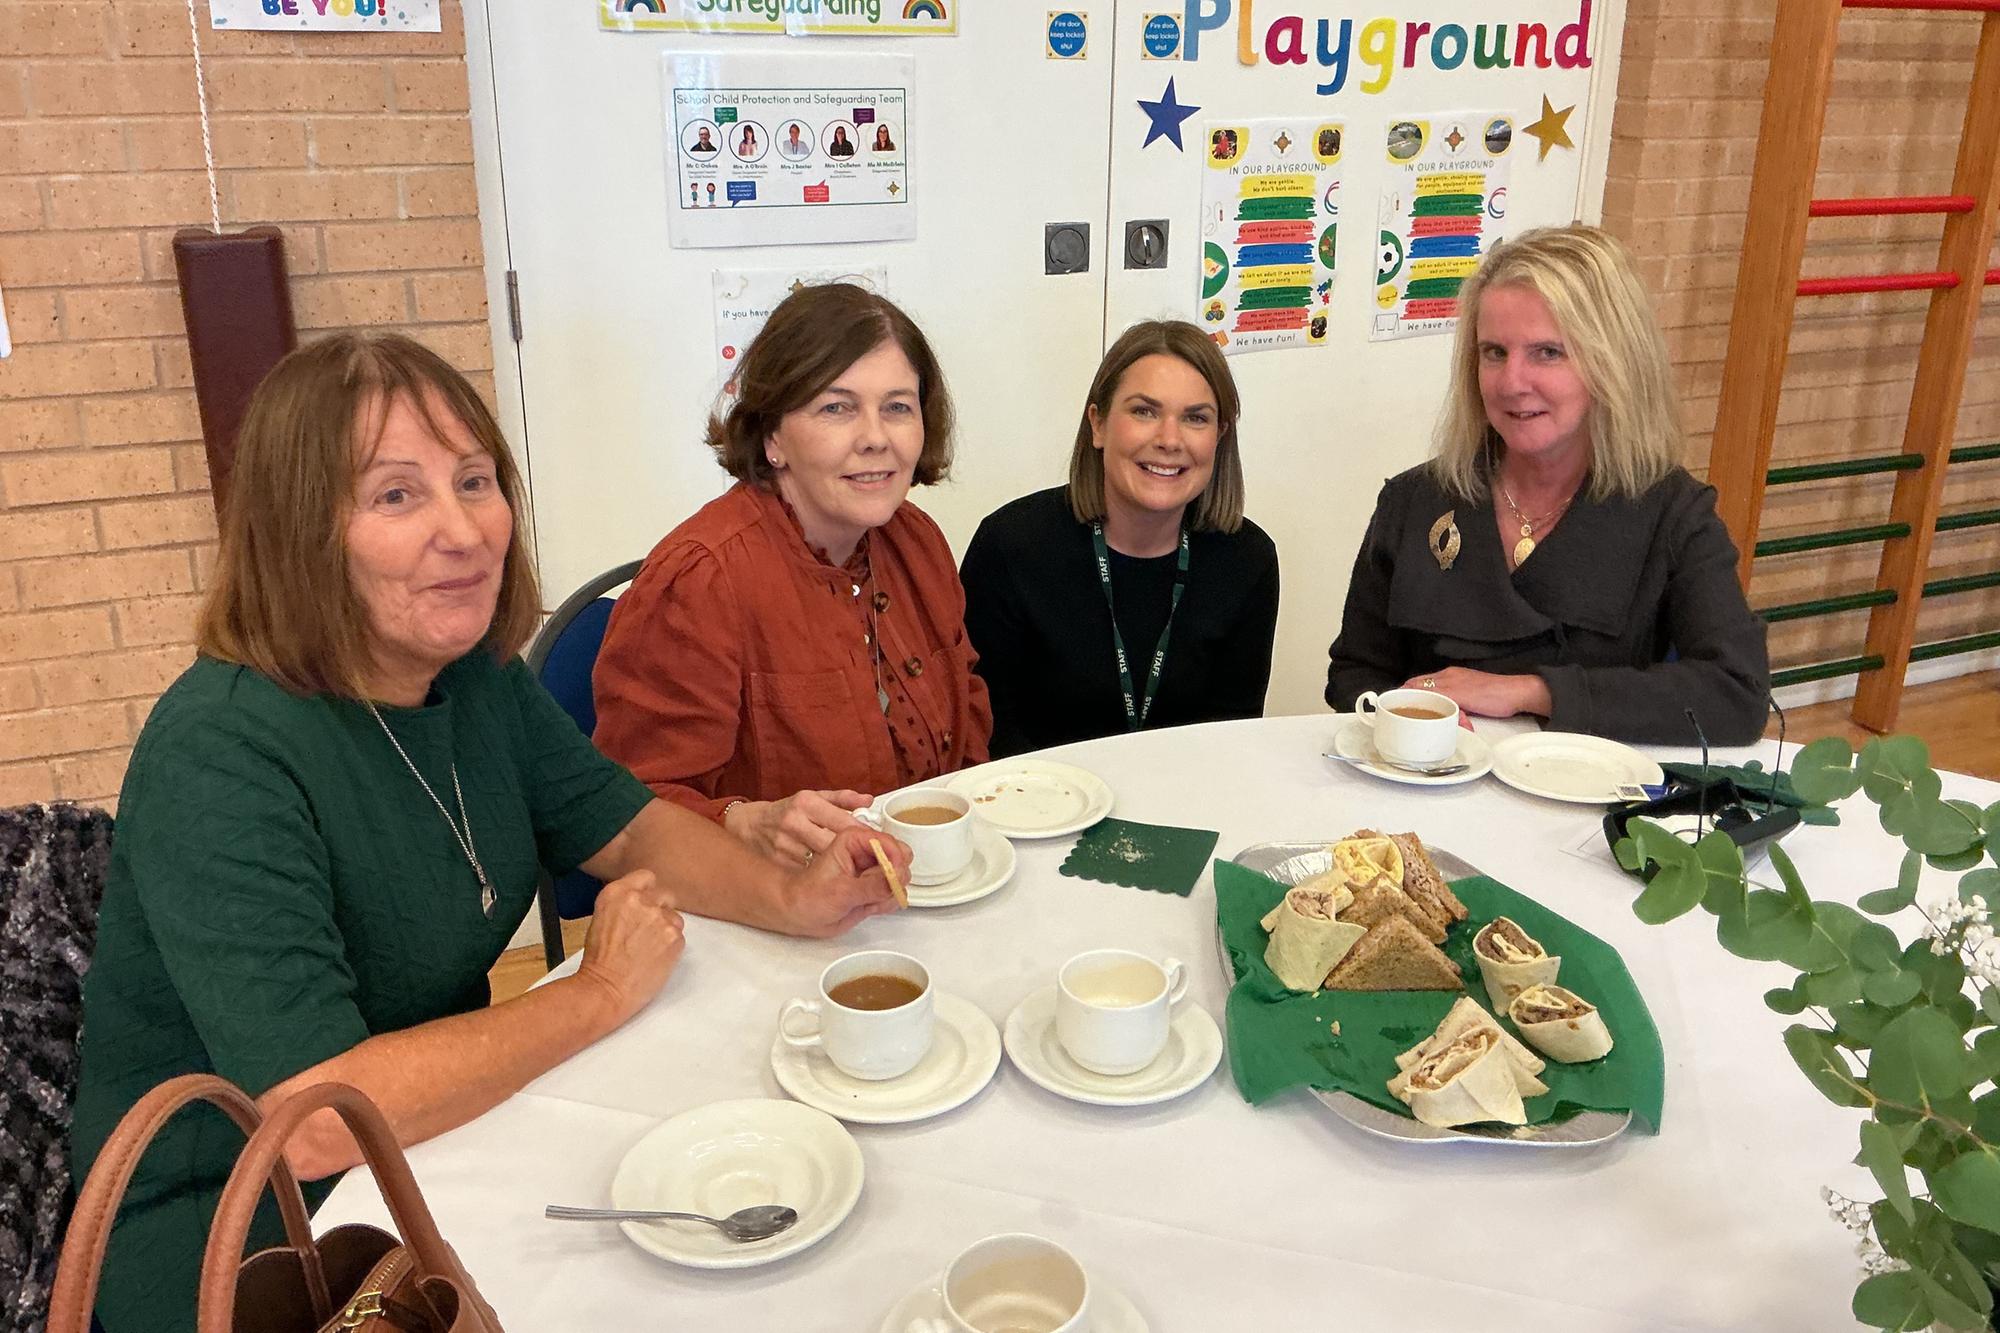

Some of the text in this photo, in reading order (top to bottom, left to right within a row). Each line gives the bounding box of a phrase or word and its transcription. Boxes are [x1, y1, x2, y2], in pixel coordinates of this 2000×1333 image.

[262, 0, 385, 17] BE YOU!
[1183, 0, 1592, 96] Playground
[677, 93, 903, 106] School Child Protection and Safeguarding Team
[1229, 162, 1327, 175] IN OUR PLAYGROUND
[1405, 160, 1495, 172] IN OUR PLAYGROUND
[722, 308, 769, 320] If you have
[1407, 322, 1419, 331] We
[1423, 321, 1442, 330] have
[1236, 333, 1296, 346] We have fun!
[1099, 556, 1110, 583] STAFF
[1117, 648, 1128, 674] STAFF
[1152, 650, 1164, 678] STAFF
[1124, 692, 1135, 717] STAFF
[1141, 696, 1152, 720] STAFF
